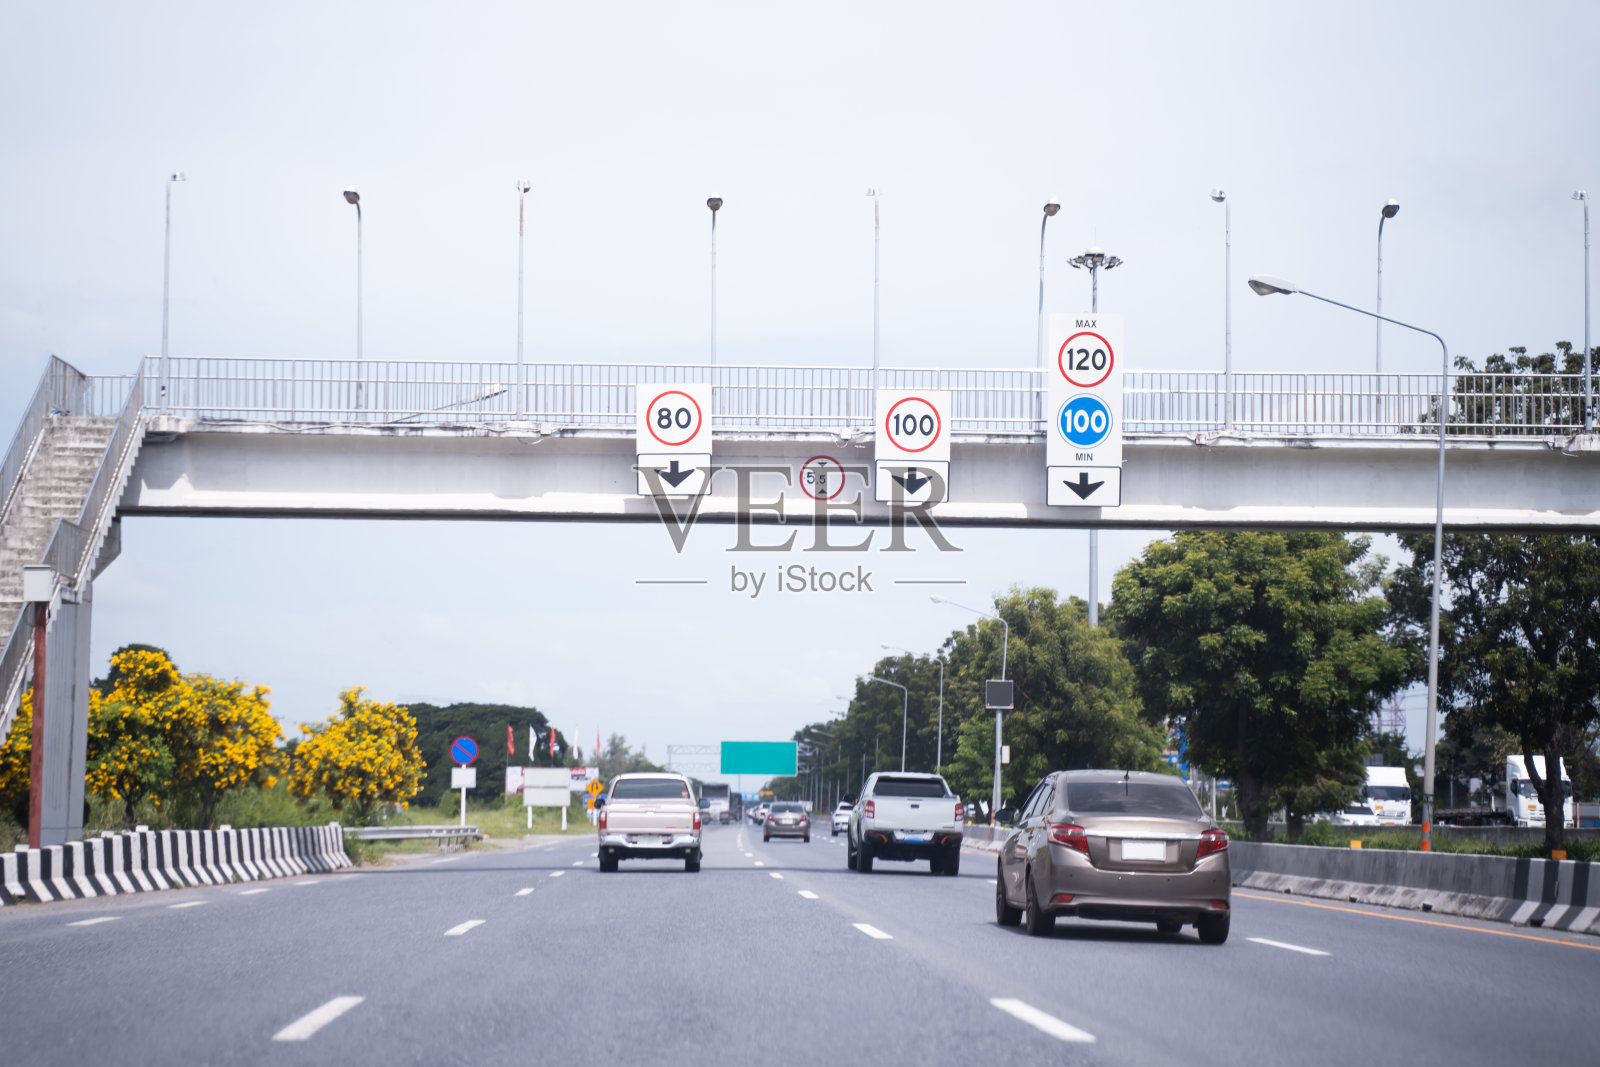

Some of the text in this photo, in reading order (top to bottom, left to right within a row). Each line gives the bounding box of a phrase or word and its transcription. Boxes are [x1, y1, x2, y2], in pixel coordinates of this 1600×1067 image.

[1075, 319, 1097, 328] MAX
[1067, 348, 1107, 370] 120
[657, 407, 692, 430] 80
[893, 414, 935, 436] 100
[1064, 409, 1107, 433] 100
[1075, 453, 1094, 462] MIN
